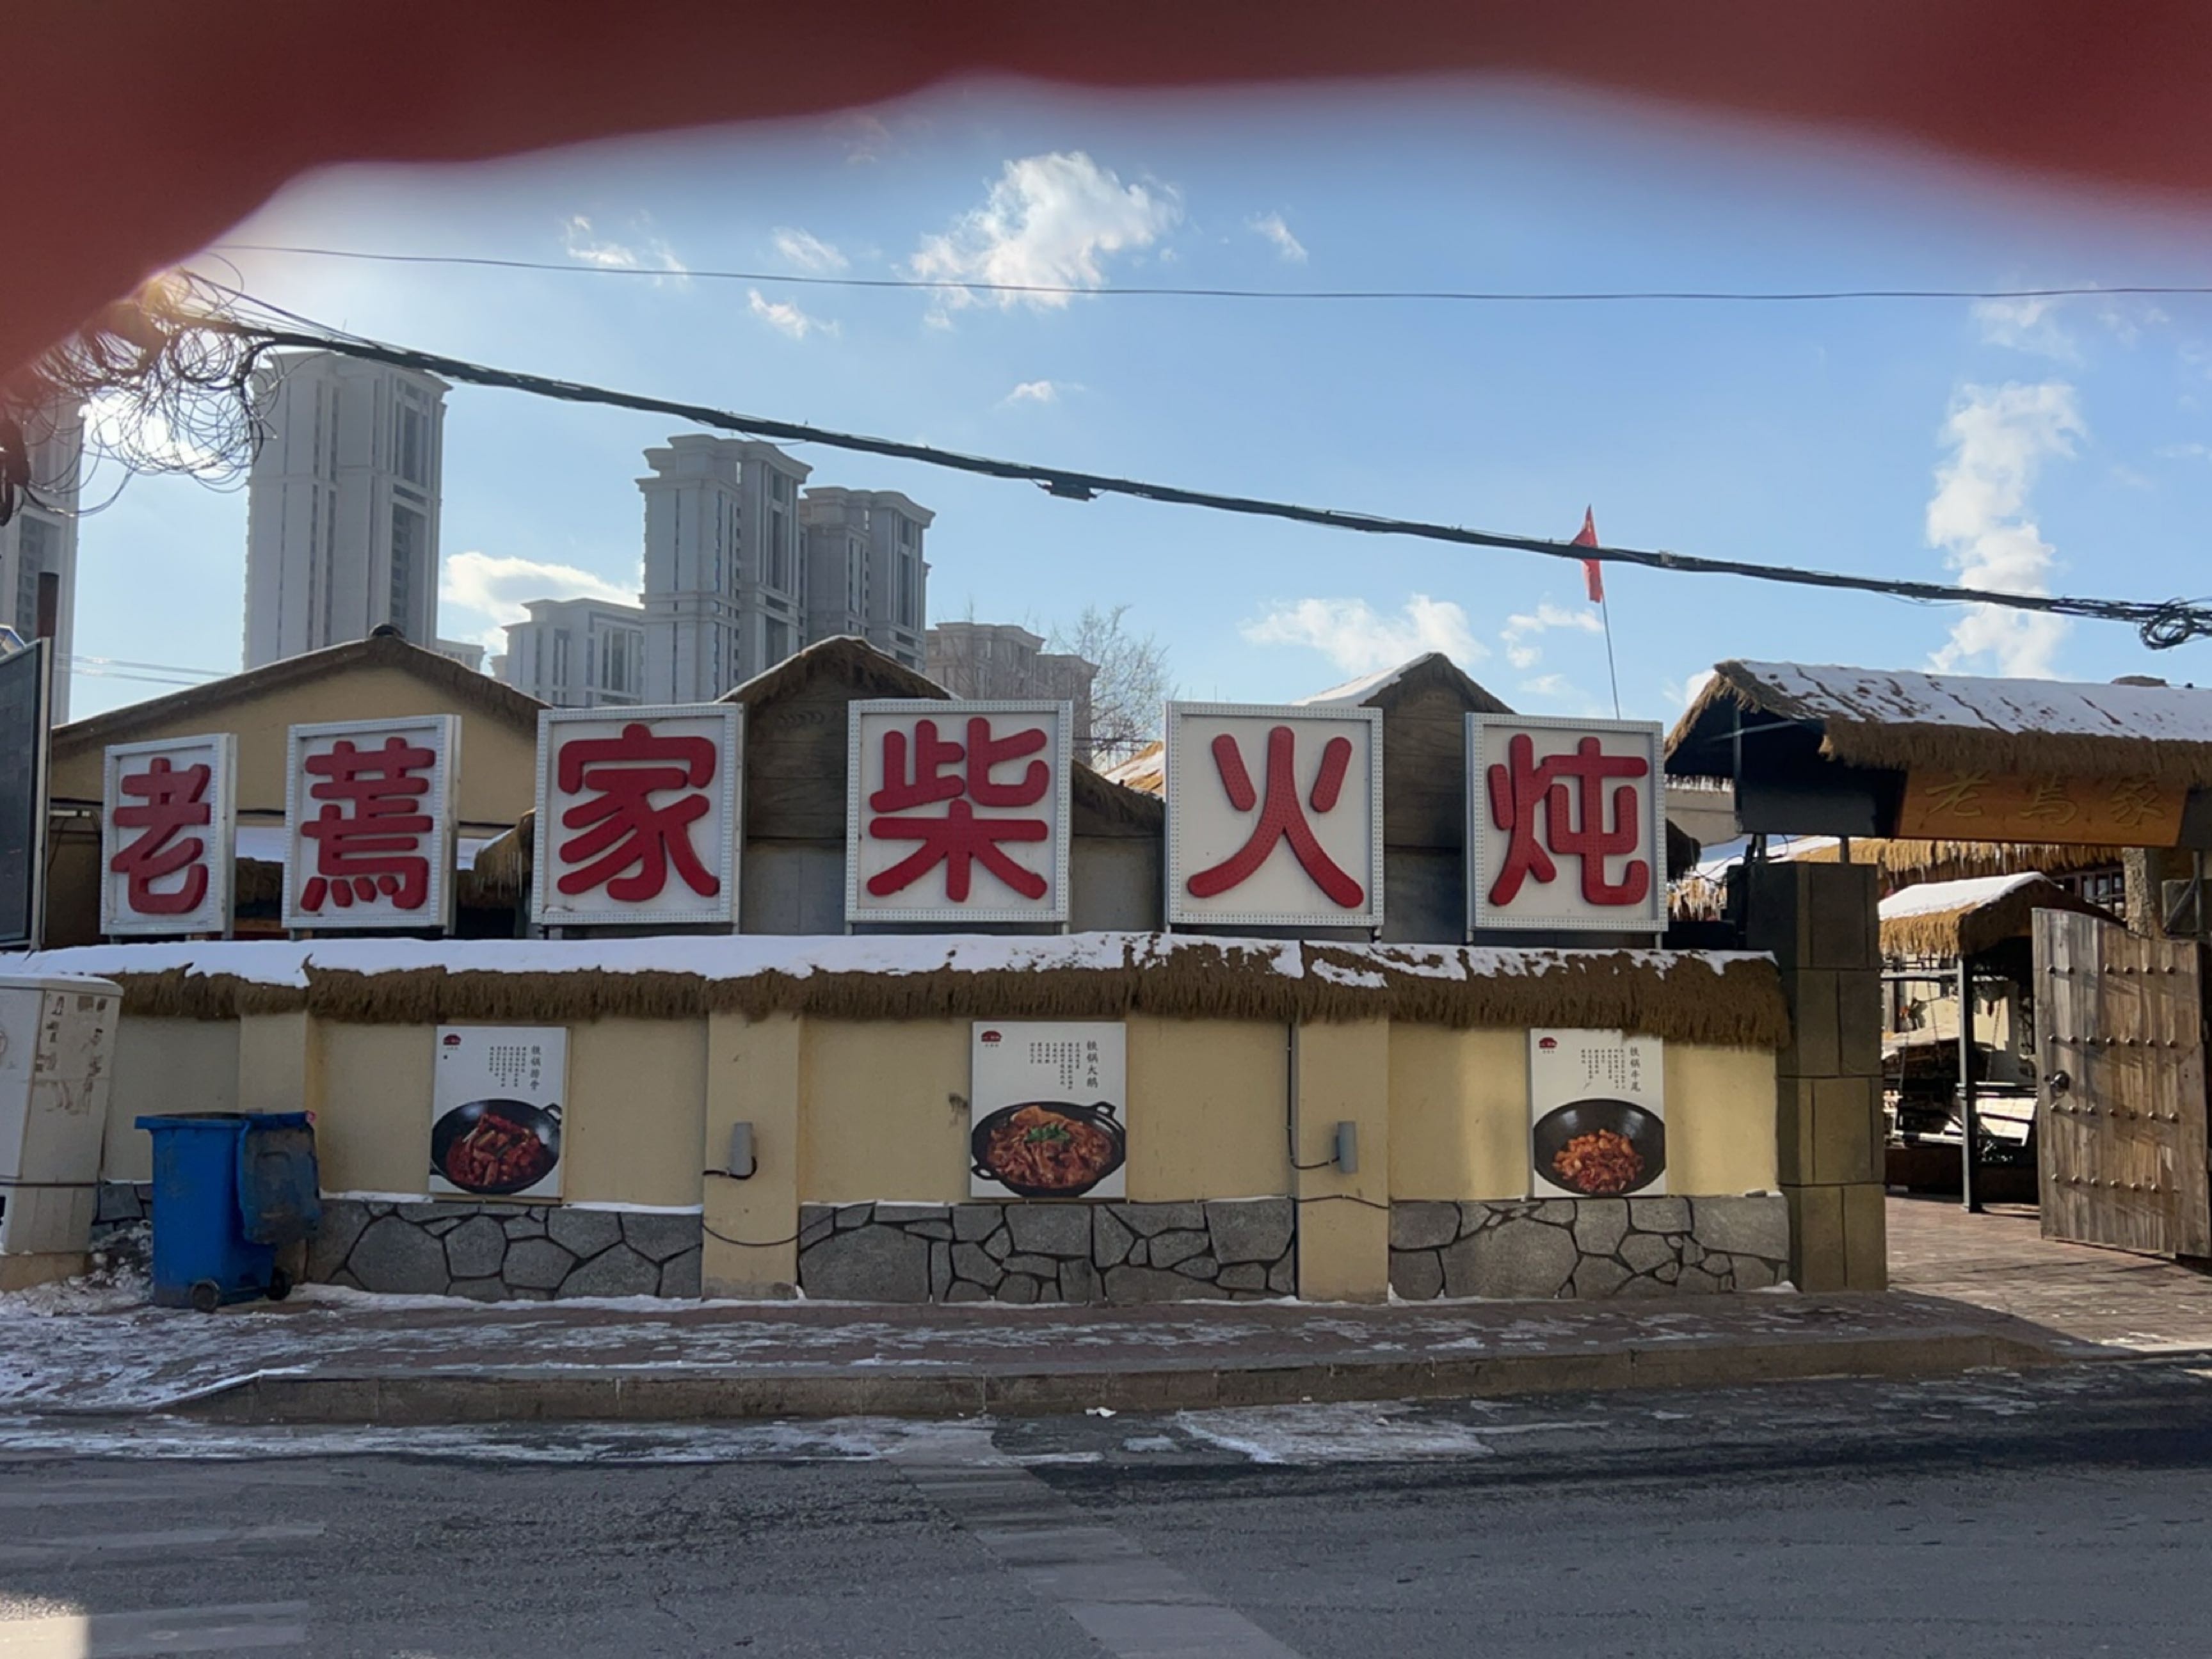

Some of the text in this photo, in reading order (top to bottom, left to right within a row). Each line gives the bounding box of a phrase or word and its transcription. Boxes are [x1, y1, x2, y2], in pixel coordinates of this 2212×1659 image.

[111, 718, 1649, 914] 老蔫家柴火炖
[1086, 1040, 1098, 1089] 铁锅大鹅
